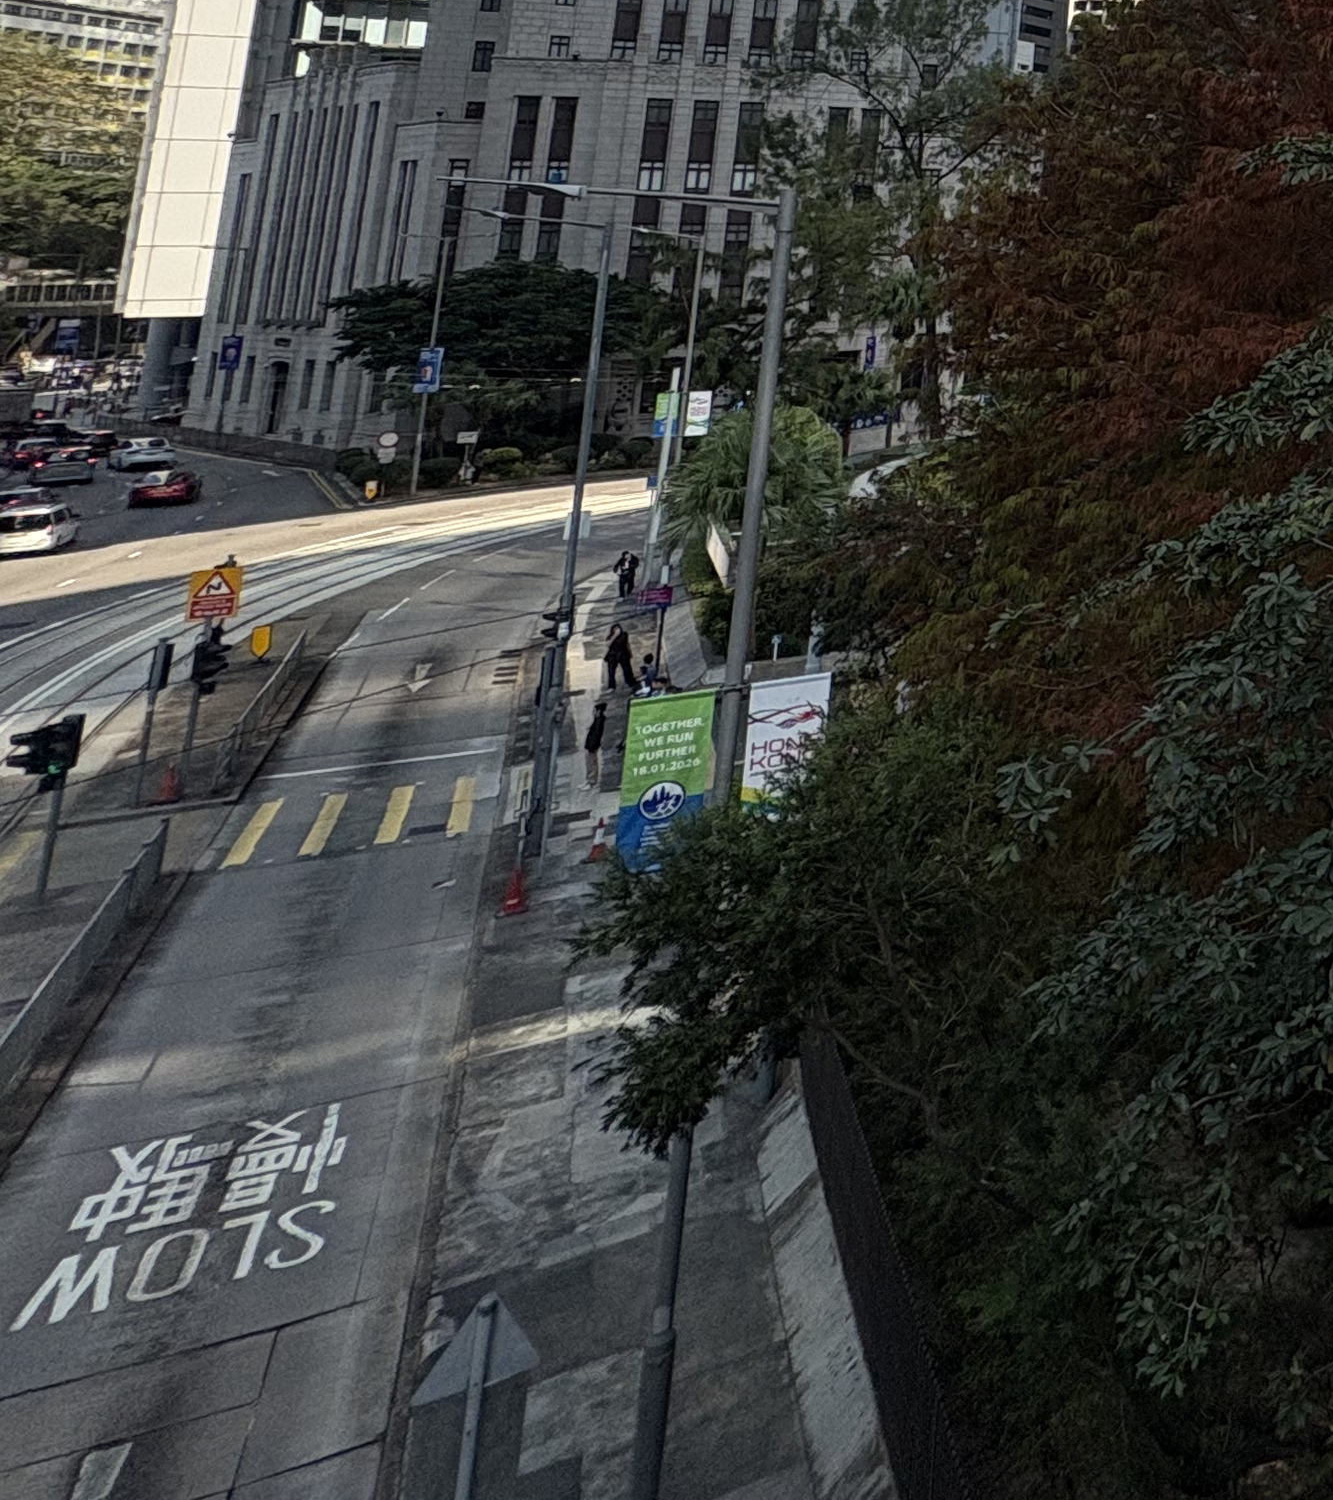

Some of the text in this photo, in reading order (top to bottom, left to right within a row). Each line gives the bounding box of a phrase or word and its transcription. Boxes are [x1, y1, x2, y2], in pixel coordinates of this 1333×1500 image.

[635, 717, 704, 735] TOGETHER
[644, 731, 694, 747] WE RUN
[750, 736, 804, 757] HON
[638, 744, 696, 762] FURTHER
[632, 757, 701, 777] 18.01.2026
[67, 1102, 348, 1242] 慢駛
[8, 1200, 336, 1332] SLOW
